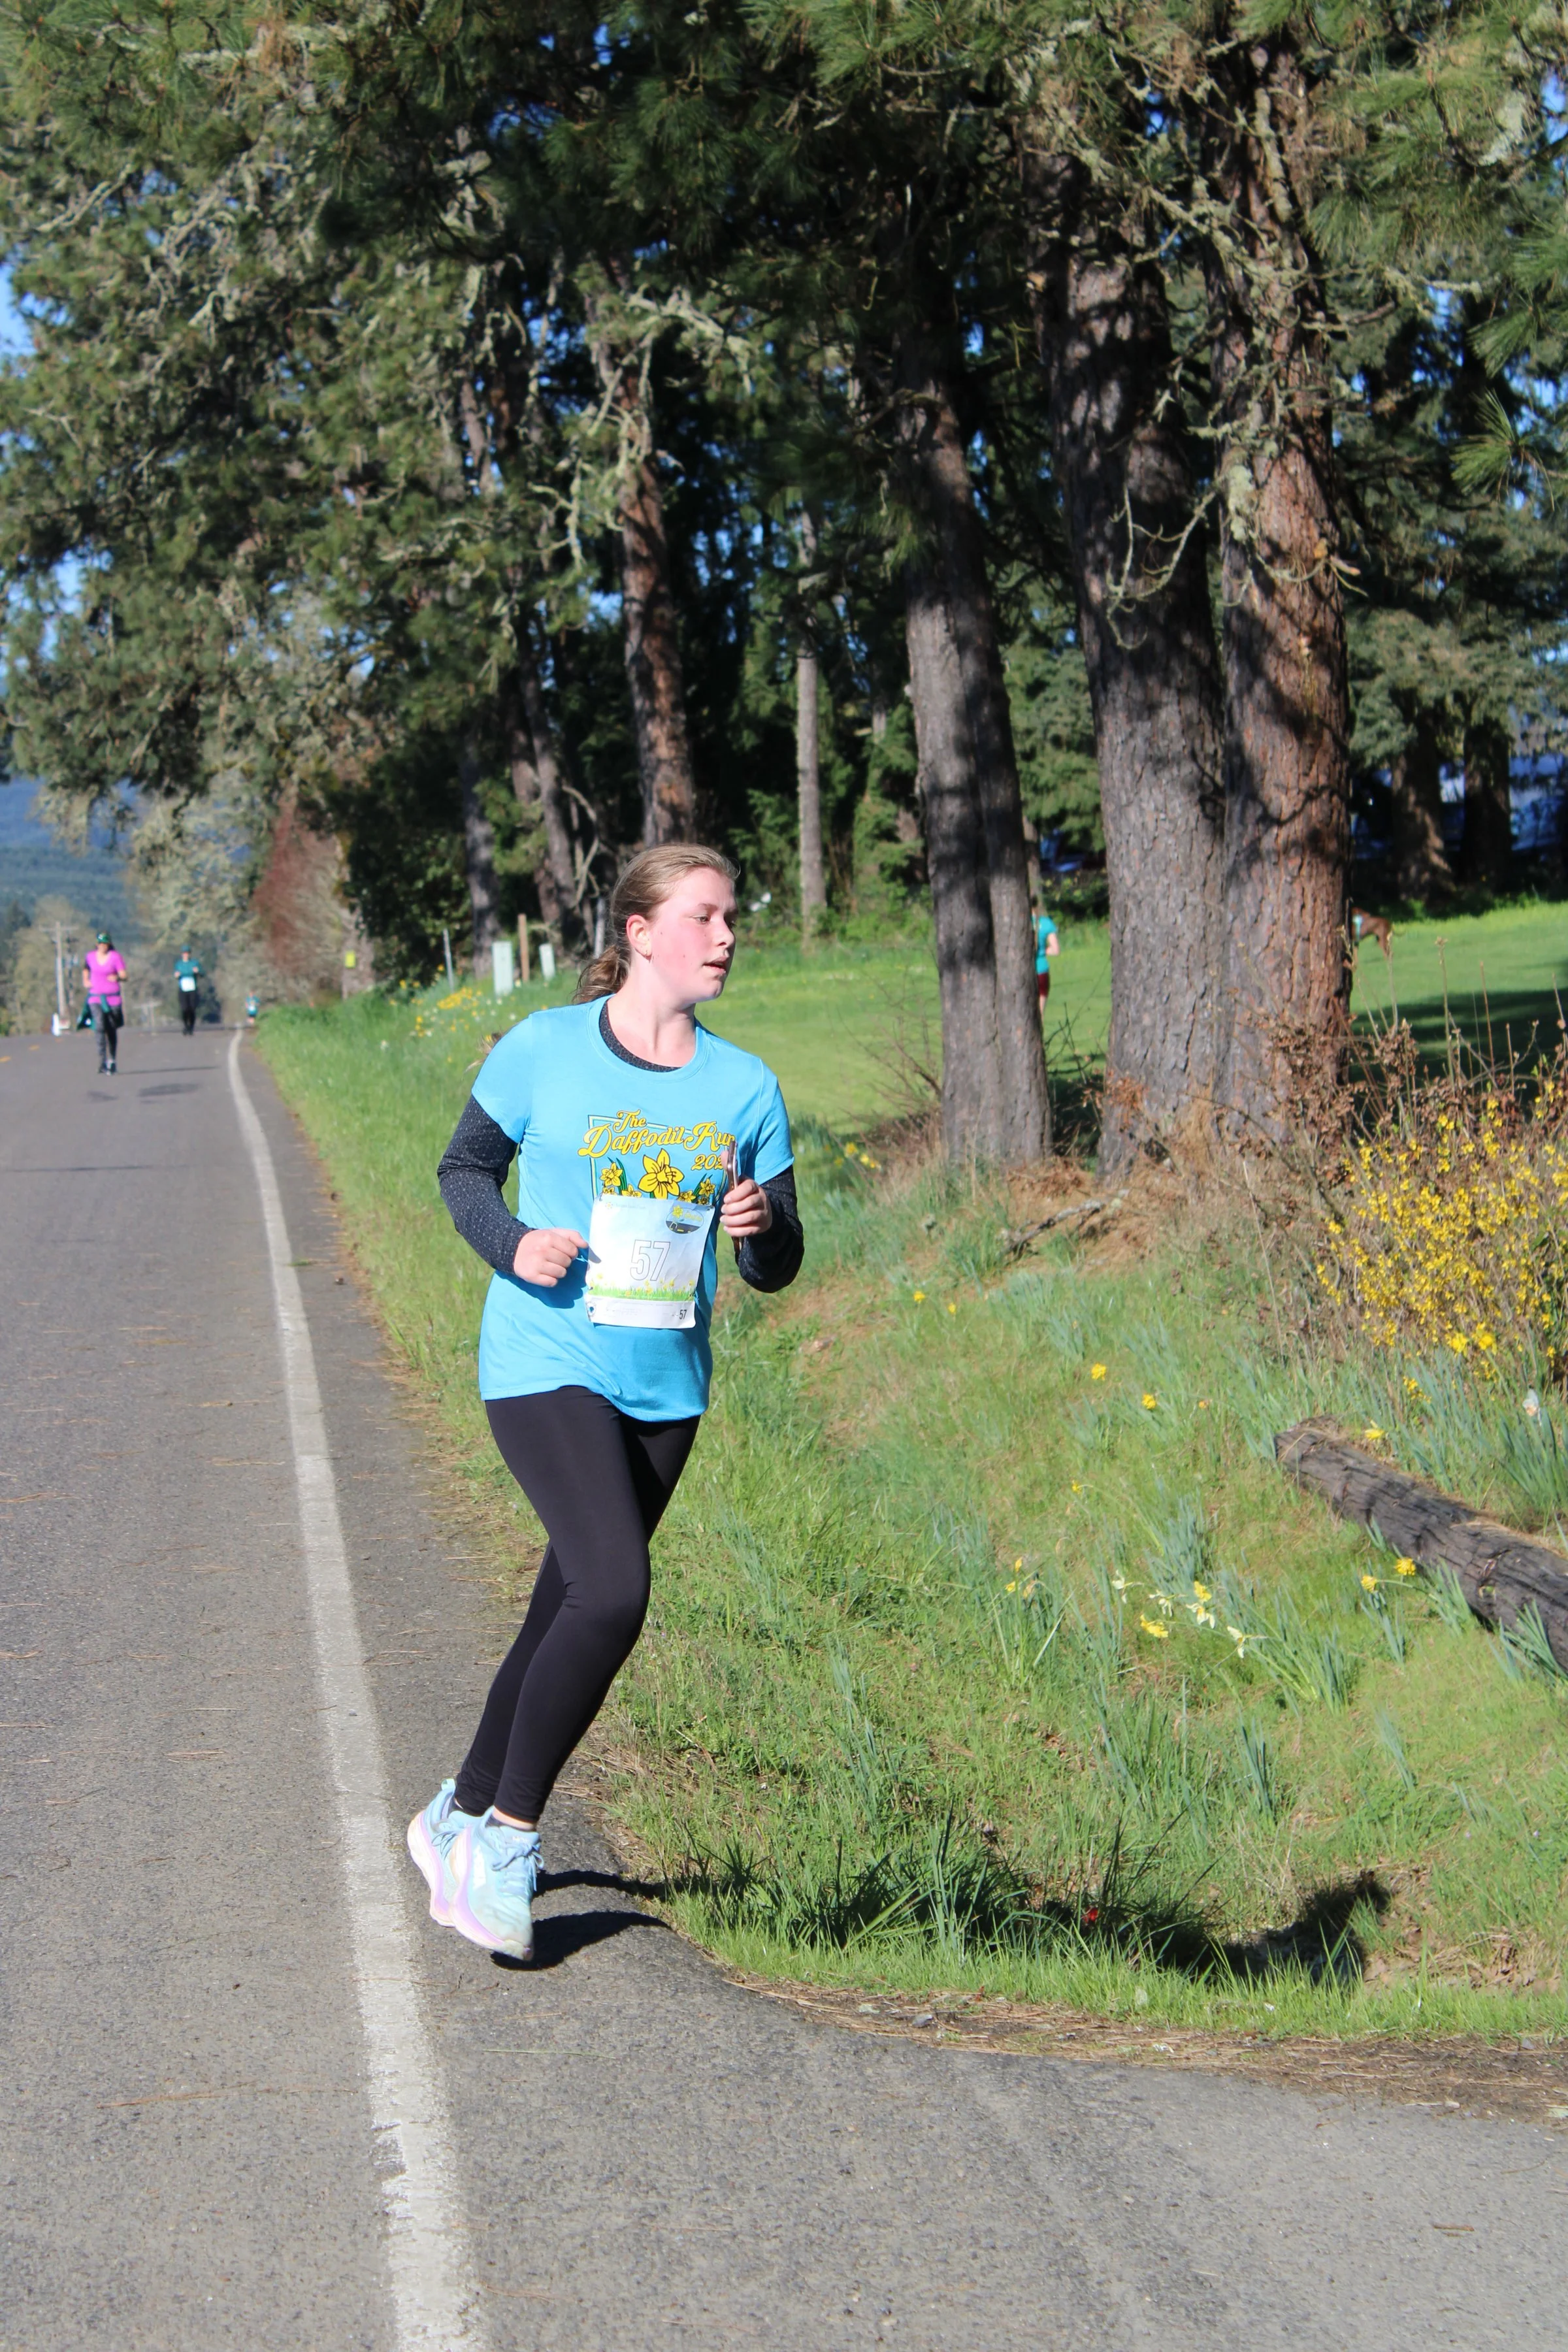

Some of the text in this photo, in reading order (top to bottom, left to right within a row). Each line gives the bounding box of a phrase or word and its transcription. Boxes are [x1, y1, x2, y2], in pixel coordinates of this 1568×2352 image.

[613, 1109, 647, 1133] The
[578, 1120, 736, 1158] Daffodil Run
[691, 1154, 725, 1171] 202
[630, 1239, 671, 1281] 57
[679, 1309, 687, 1319] 57
